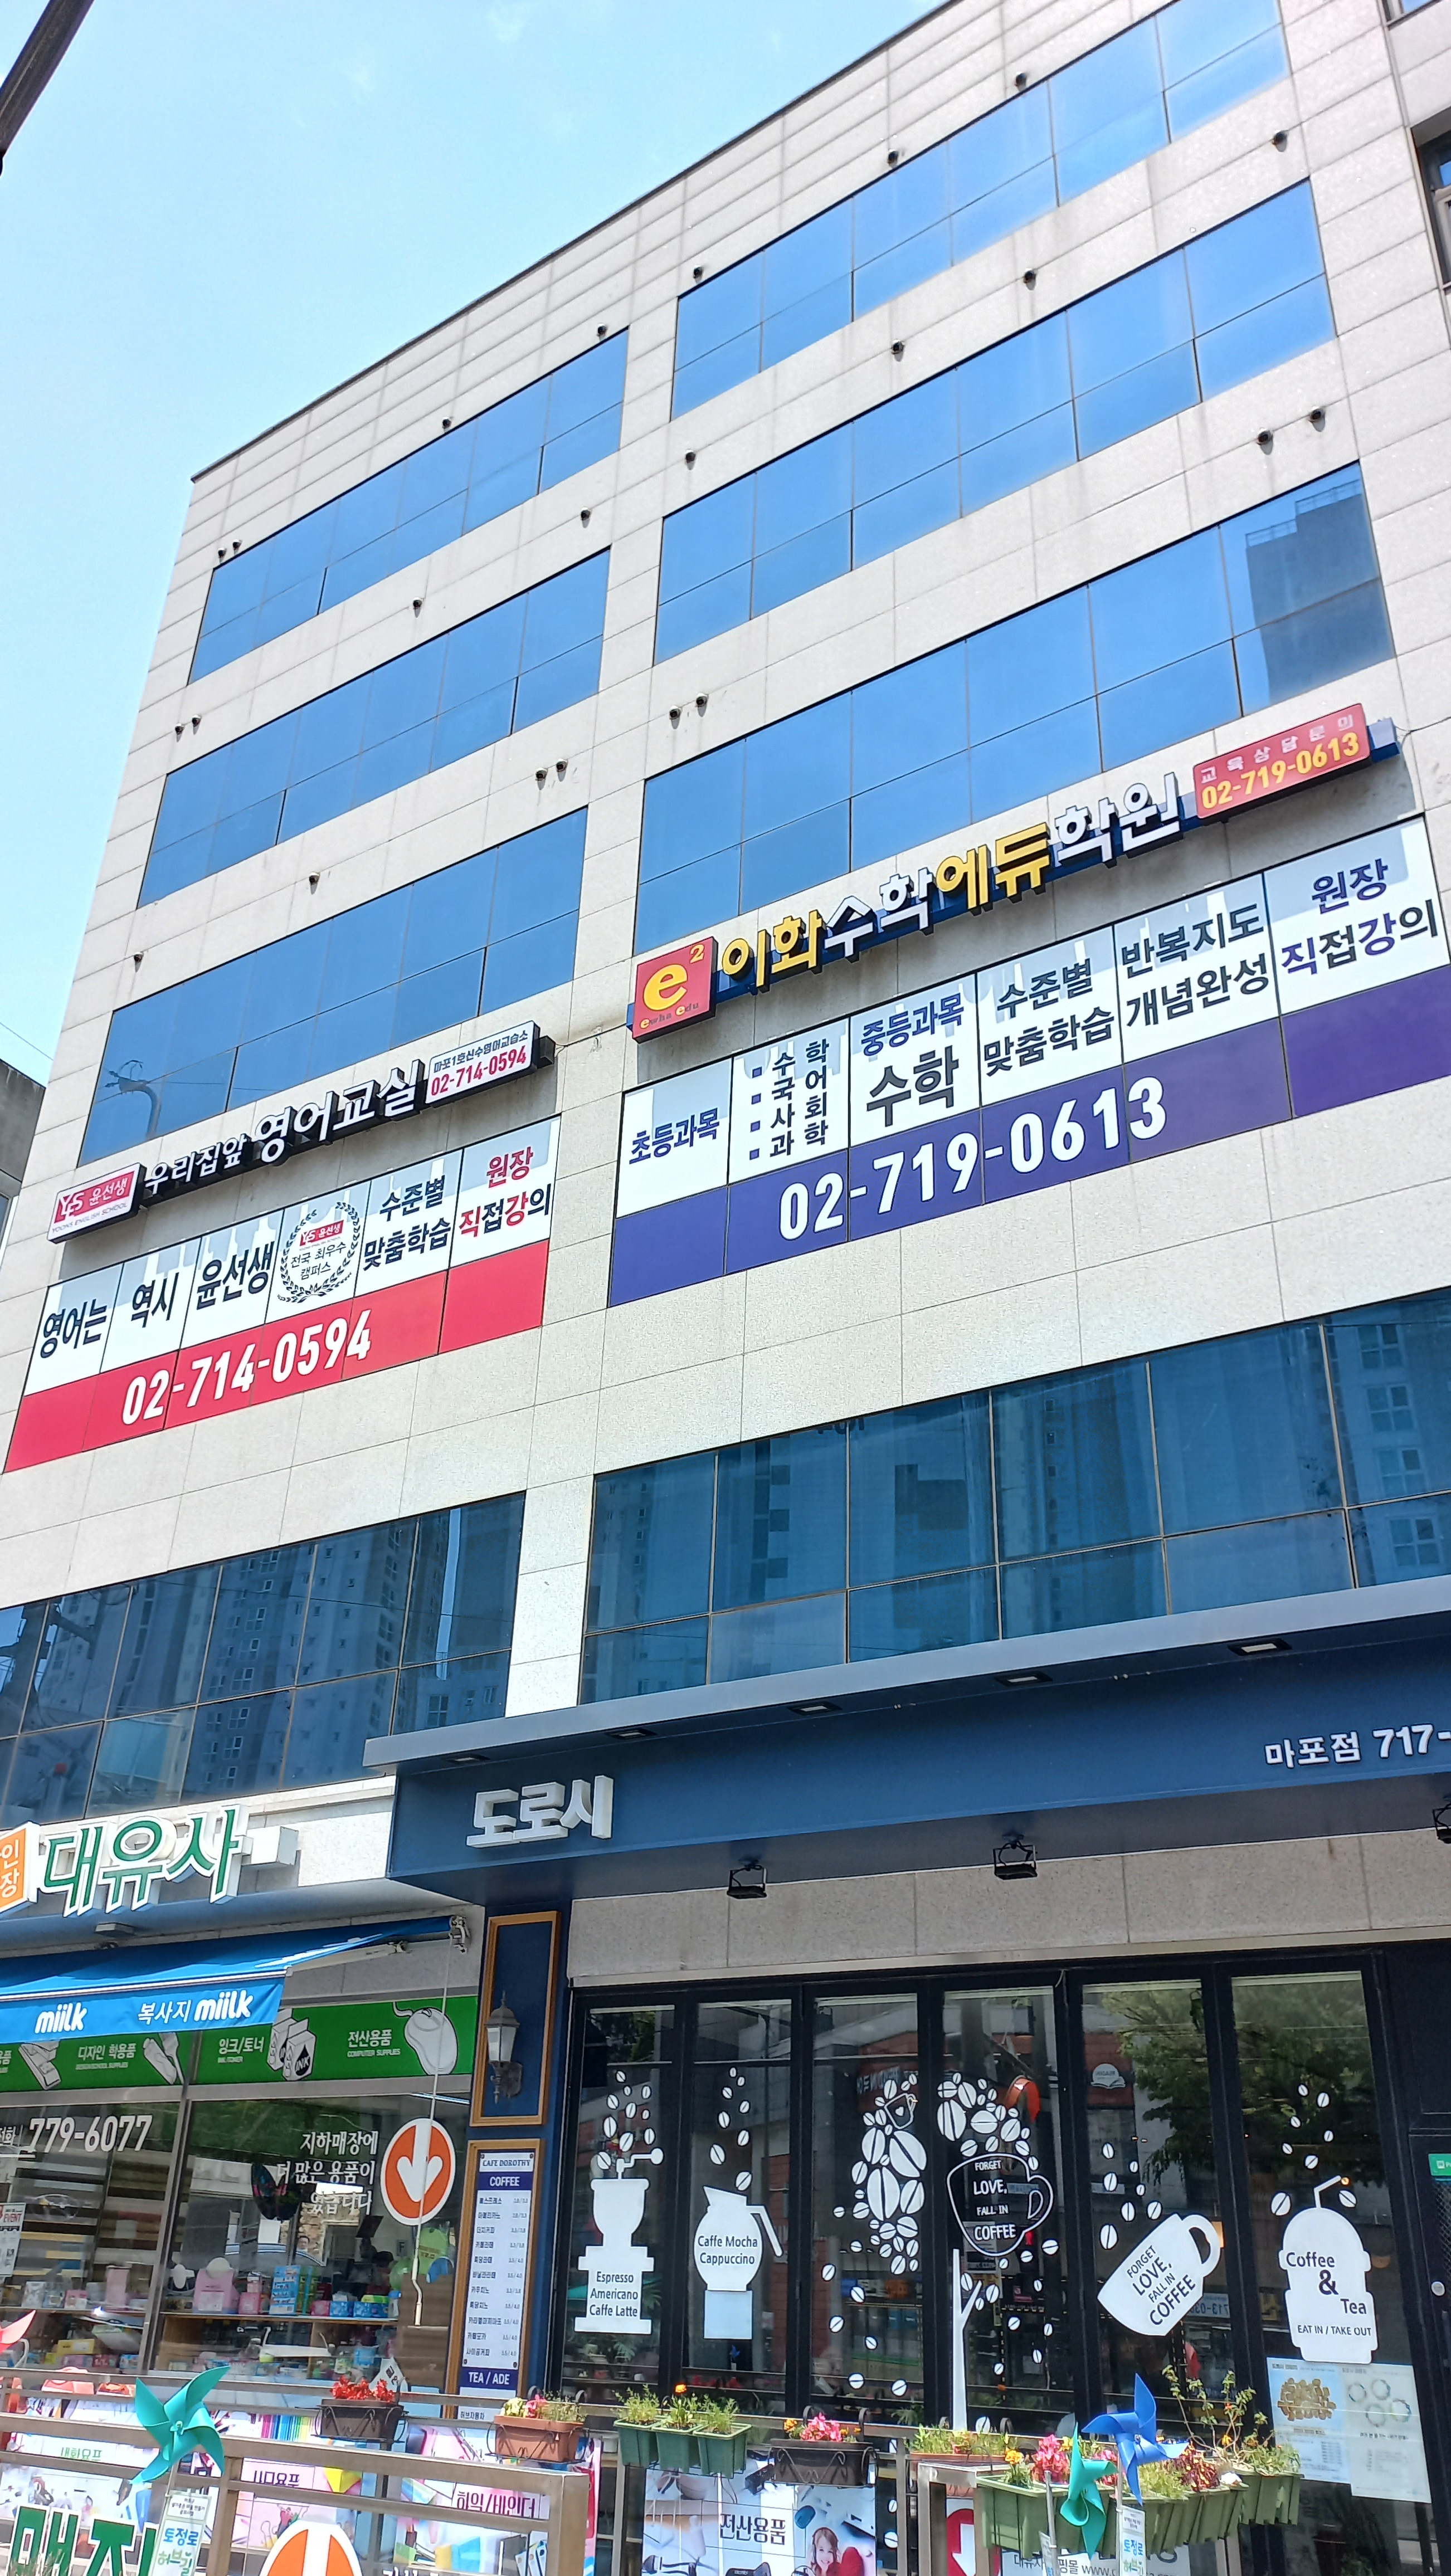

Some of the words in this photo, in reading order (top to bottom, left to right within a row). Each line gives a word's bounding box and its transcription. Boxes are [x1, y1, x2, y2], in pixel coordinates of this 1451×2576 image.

[1202, 732, 1359, 809] 02-719-0613
[1311, 858, 1389, 914] 원장
[1121, 904, 1265, 979] 반복지도
[1282, 899, 1439, 975] 직접강의
[998, 958, 1093, 1019] 수준별
[1126, 953, 1269, 1027] 개념완성
[861, 992, 964, 1056] 중등과목
[772, 1039, 830, 1076] 수학
[984, 1006, 1115, 1077] 맞춤학습
[431, 1045, 527, 1096] 02-714-0594
[771, 1066, 828, 1101] 국어
[866, 1045, 959, 1128] 수학
[144, 1133, 249, 1194] 우리집앞
[255, 1060, 419, 1160] 영어교실
[771, 1092, 828, 1130] 사회
[629, 1106, 720, 1164] 초등과목
[770, 1119, 829, 1159] 과학
[486, 1146, 534, 1188] 원장
[780, 1076, 1166, 1240] 02-719-0613
[89, 1177, 128, 1207] 윤선생
[380, 1174, 445, 1221] 수준별
[459, 1182, 551, 1237] 직접강의
[291, 1252, 310, 1269] 전국
[314, 1242, 346, 1260] 최우수
[364, 1217, 452, 1272] 맞춤학습
[300, 1262, 331, 1280] 캠퍼스
[40, 1297, 108, 1359] 영어는
[131, 1272, 178, 1329] 역시
[197, 1241, 275, 1310] 윤선생
[123, 1309, 372, 1425] 02-714-0594
[1264, 1731, 1361, 1769] 마포점
[466, 1774, 613, 1848] 도로시
[43, 1807, 241, 1915] 대유사
[138, 1999, 192, 2026] 복사지
[77, 2045, 105, 2061] 디자인
[108, 2043, 137, 2060] 학용품
[218, 2036, 265, 2055] 잉크/토너
[347, 2029, 392, 2048] 전산용품
[30, 2115, 153, 2153] 779-6077
[300, 2130, 379, 2155] 지하매장에
[295, 2160, 325, 2184] 많은
[328, 2160, 376, 2185] 용품이
[489, 2176, 520, 2187] COFFEE
[975, 2160, 1002, 2171] FORGET
[976, 2205, 996, 2216] FALL
[999, 2204, 1009, 2214] IN
[698, 2236, 722, 2248] Caffe
[725, 2236, 758, 2248] Mocha
[974, 2224, 1016, 2241] COFFEE
[700, 2253, 755, 2268] Cappuccino
[1127, 2245, 1157, 2279] FORGET
[1286, 2251, 1336, 2268] Coffee
[590, 2288, 638, 2300] Americano
[596, 2271, 634, 2284] Espresso
[1148, 2282, 1167, 2304] FALL
[1165, 2272, 1176, 2286] IN
[1319, 2269, 1338, 2295] &
[590, 2304, 613, 2317] Caffe
[615, 2305, 638, 2318] Latte
[1149, 2275, 1196, 2326] COFFEE
[1340, 2298, 1367, 2315] Tea
[1297, 2324, 1313, 2334] EAT
[1314, 2325, 1323, 2335] IN
[1331, 2325, 1352, 2336] TAKE
[1353, 2326, 1372, 2337] OUT
[468, 2372, 484, 2384] TEA
[492, 2373, 510, 2385] ADE
[163, 2528, 199, 2546] 토정로
[719, 2513, 786, 2545] 전산용품
[1124, 2539, 1143, 2556] 토정로
